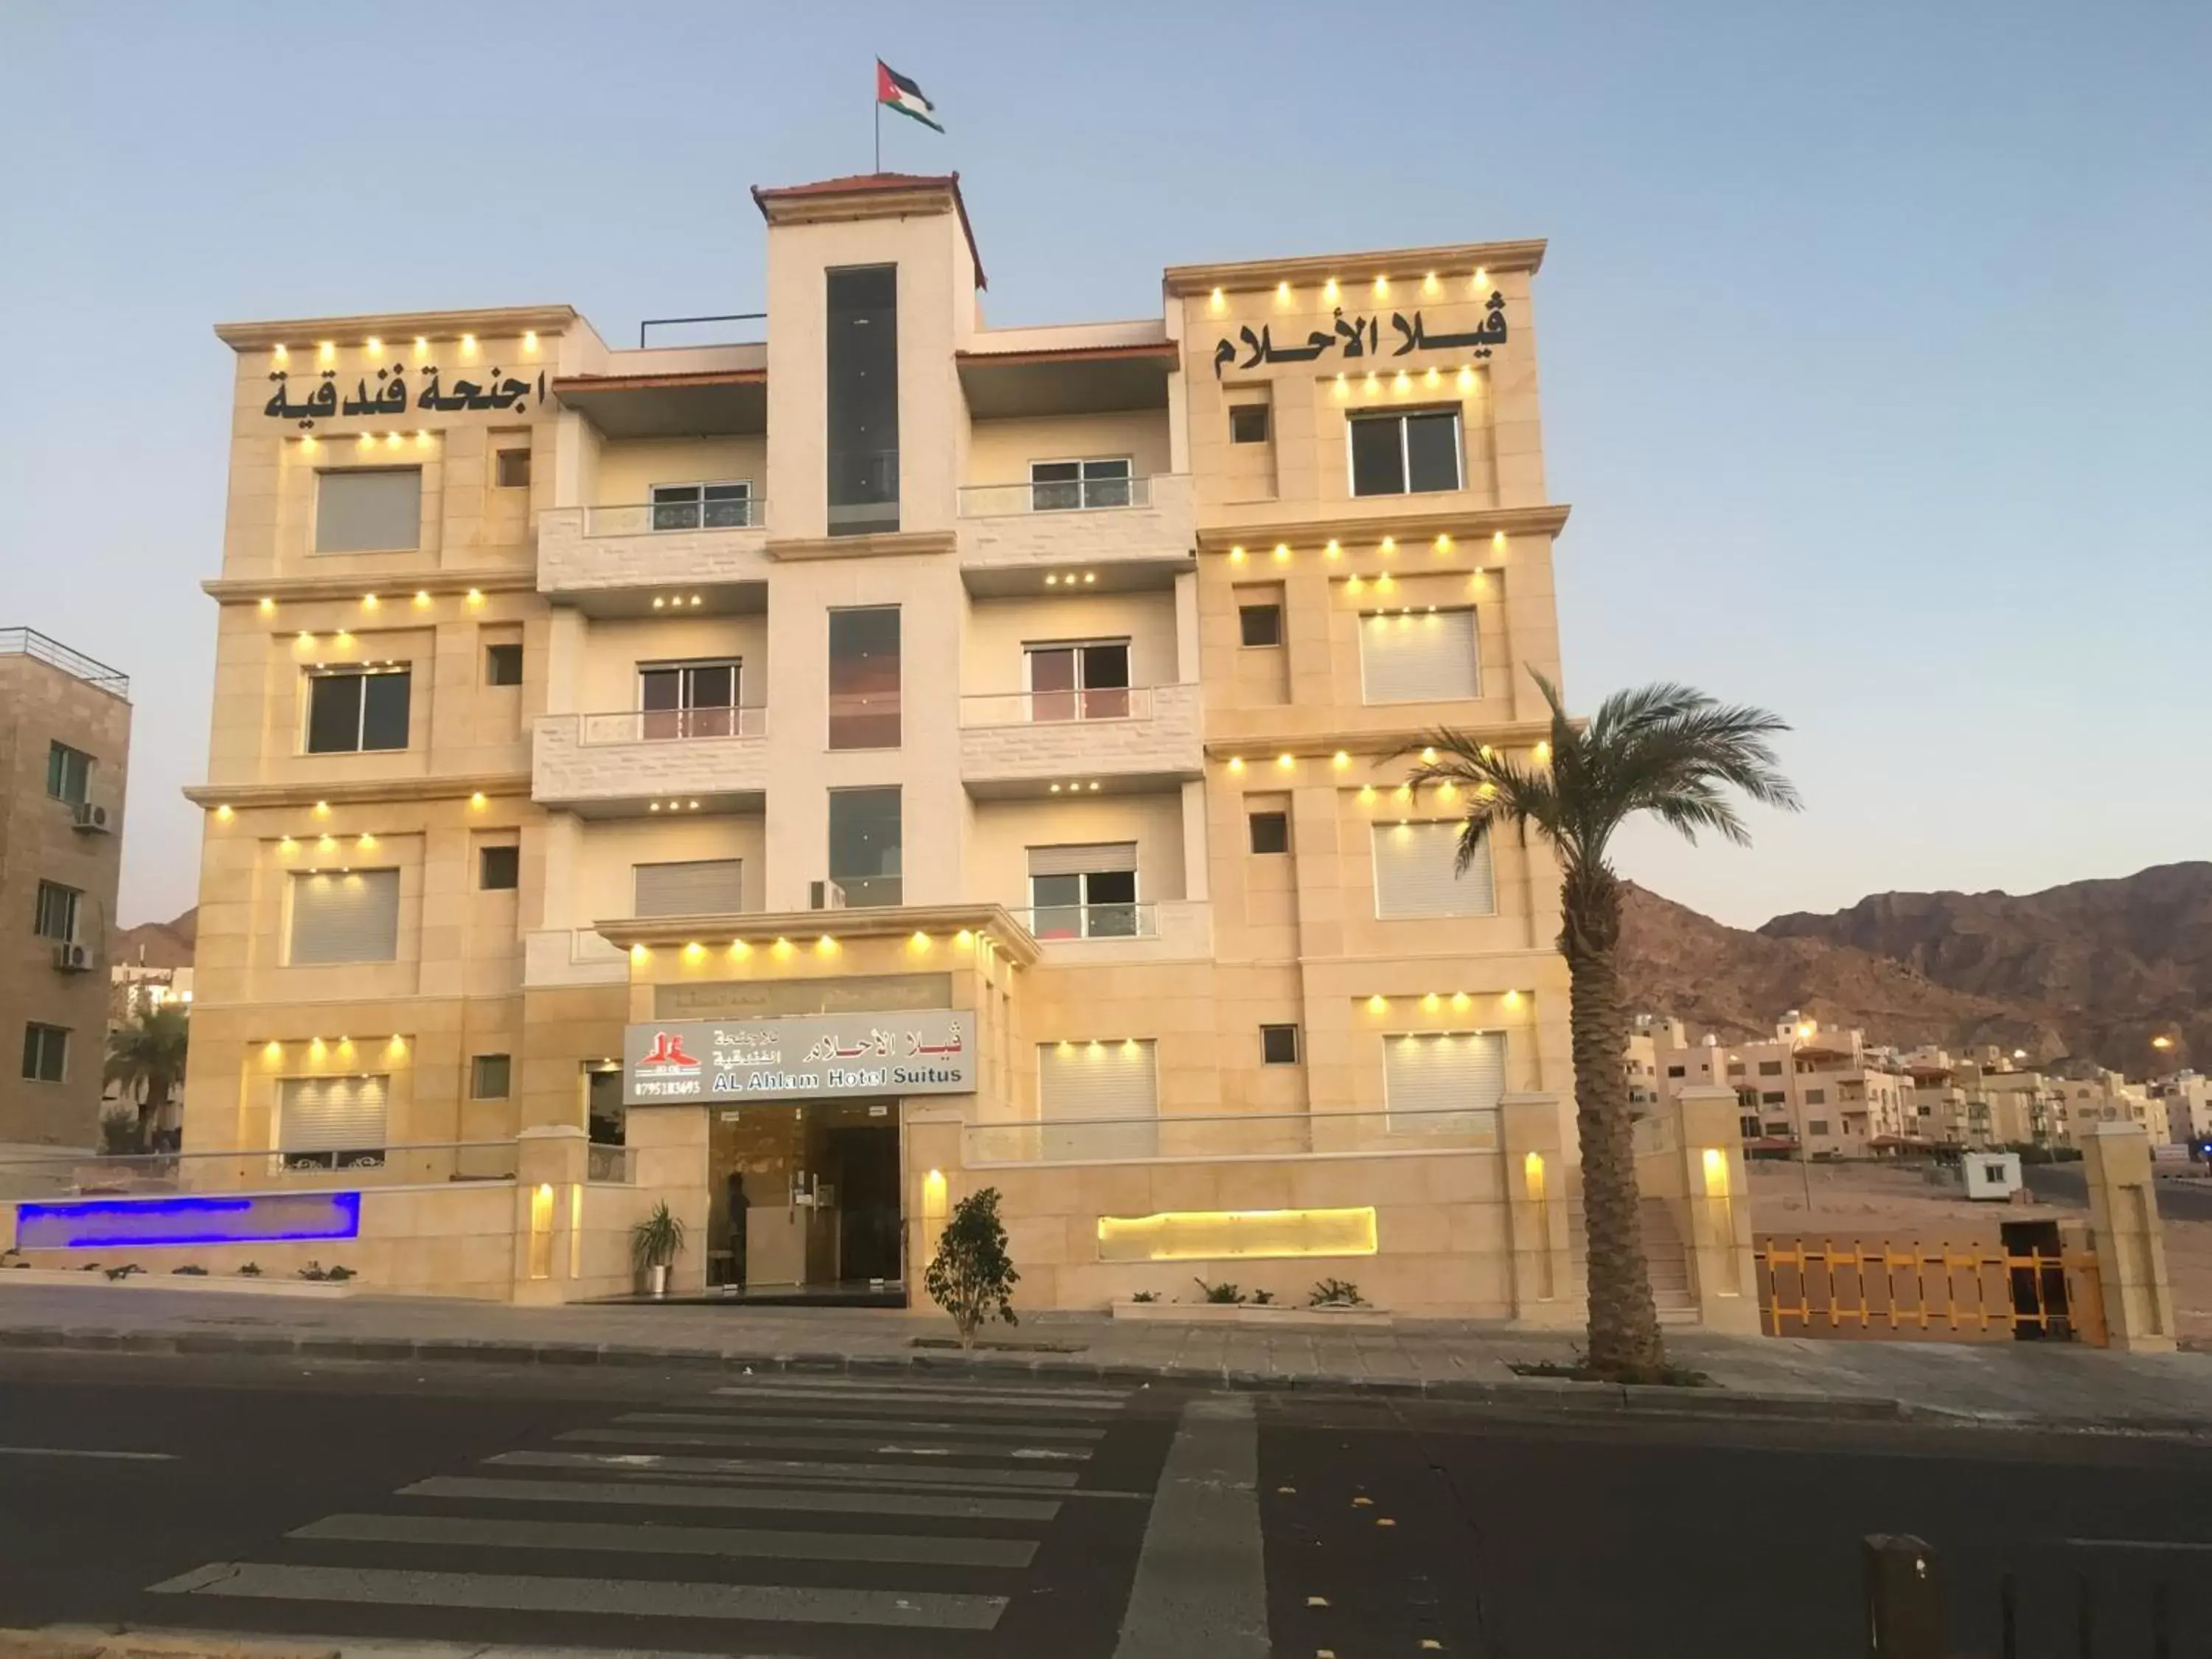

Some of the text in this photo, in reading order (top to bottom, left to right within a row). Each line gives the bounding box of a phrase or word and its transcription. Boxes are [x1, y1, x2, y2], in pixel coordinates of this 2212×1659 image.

[1214, 307, 1379, 380] الأحلام
[263, 363, 546, 429] اجنحة فندقية
[712, 1066, 962, 1093] AL Ahlam Hotel Suitus
